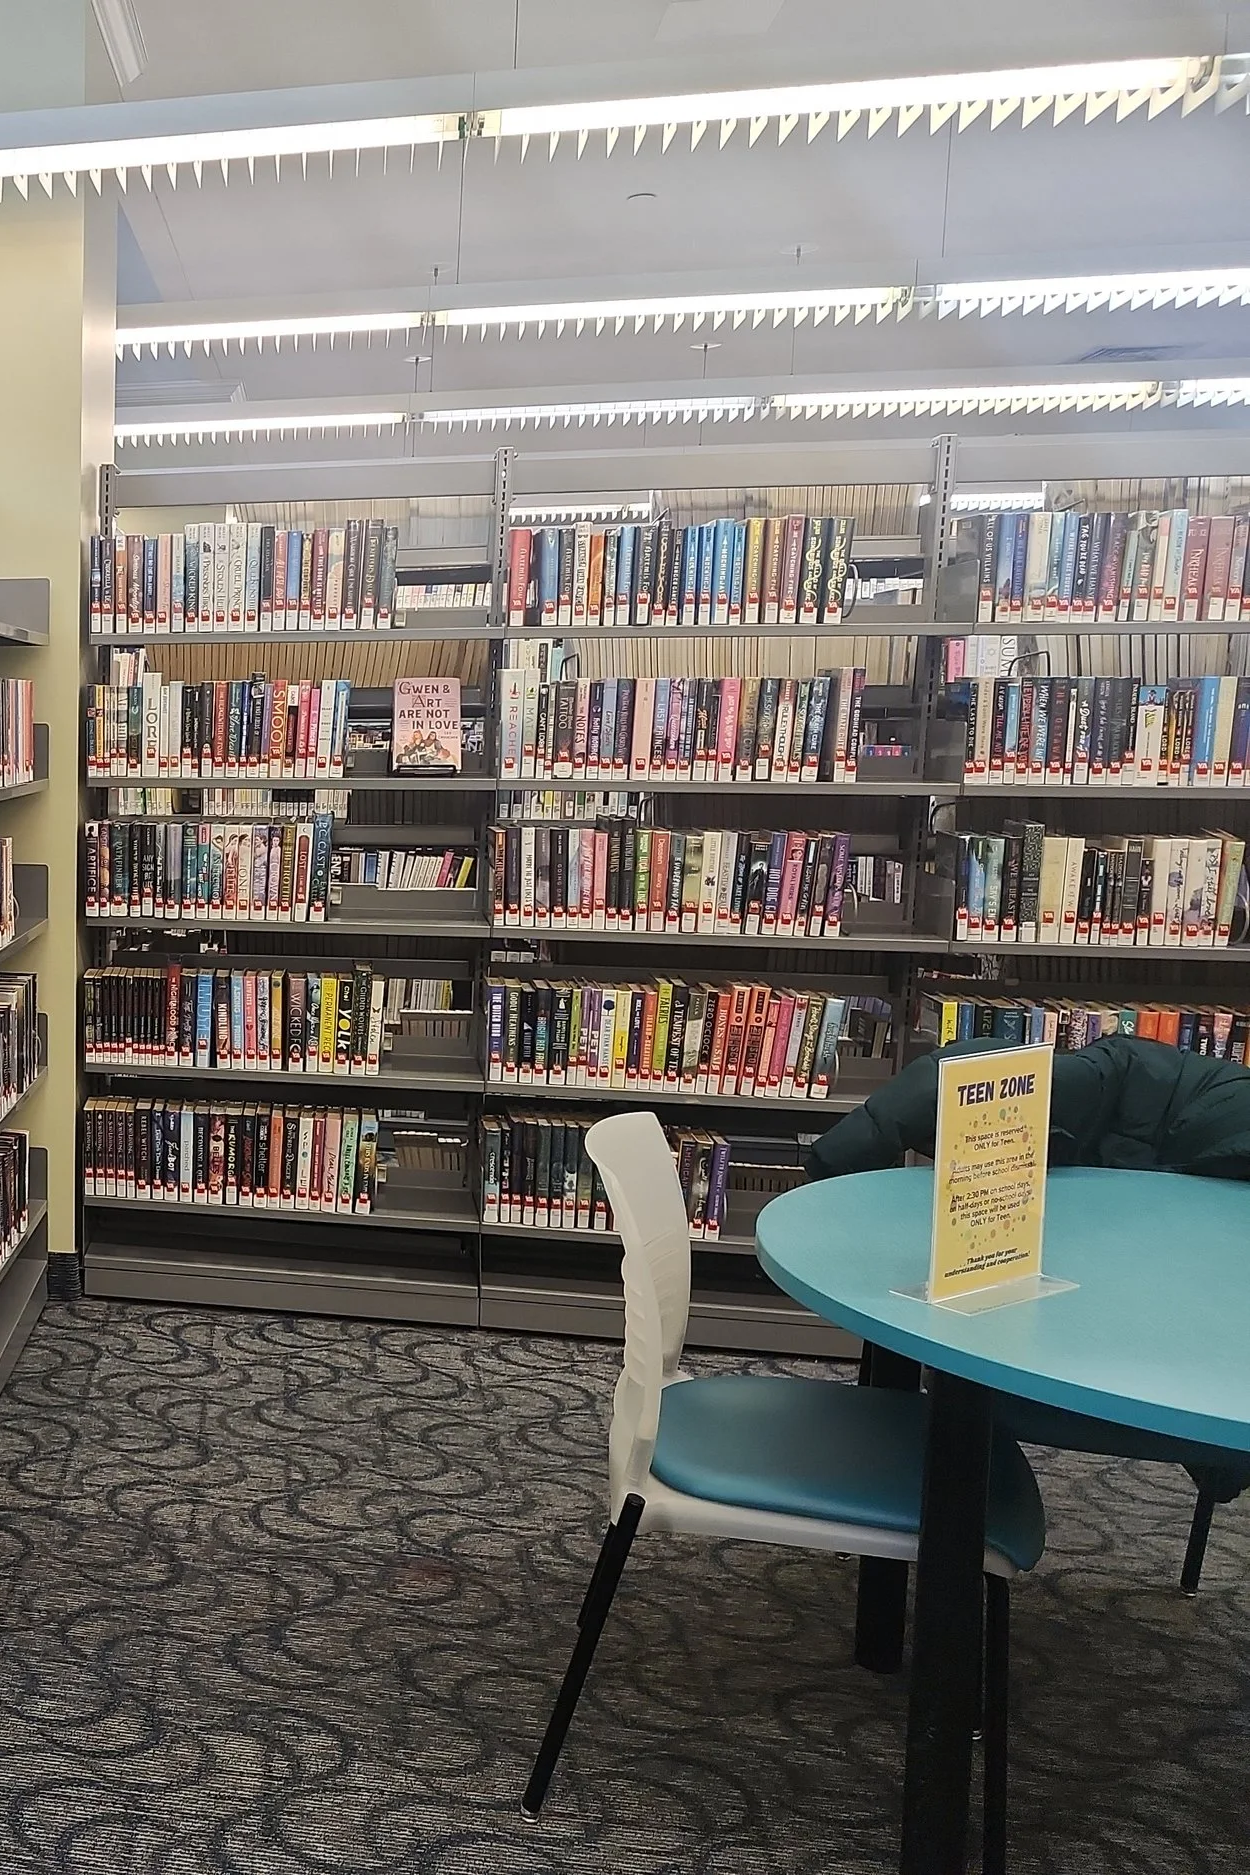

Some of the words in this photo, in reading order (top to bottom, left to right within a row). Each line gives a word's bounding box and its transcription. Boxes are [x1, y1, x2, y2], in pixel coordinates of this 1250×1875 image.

[983, 552, 992, 583] VILLAINS
[399, 682, 439, 695] GWEN
[443, 685, 450, 693] &
[412, 695, 442, 708] ART
[399, 710, 422, 718] ARE
[426, 709, 450, 719] NOT
[412, 721, 424, 729] IN
[429, 720, 458, 730] LOVE
[87, 847, 97, 893] ARTIFICE
[115, 841, 123, 888] PATHFINDER
[218, 1003, 228, 1040] KINDLING
[290, 995, 303, 1034] WICKED
[579, 1027, 588, 1053] PET
[957, 1081, 995, 1107] TEEN
[1000, 1073, 1036, 1099] ZONE
[965, 1135, 977, 1143] This
[978, 1134, 993, 1142] space
[1000, 1126, 1024, 1136] reserved
[974, 1142, 990, 1151] ONLY
[966, 1191, 979, 1200] 2:30
[980, 1188, 989, 1197] PM
[998, 1183, 1016, 1192] school
[960, 1212, 970, 1220] this
[972, 1209, 988, 1219] space
[990, 1206, 999, 1214] will
[999, 1203, 1006, 1211] be
[1007, 1200, 1020, 1210] used
[971, 1217, 988, 1227] ONLY
[988, 1215, 996, 1223] for
[944, 1262, 987, 1278] understanding
[986, 1259, 997, 1267] and
